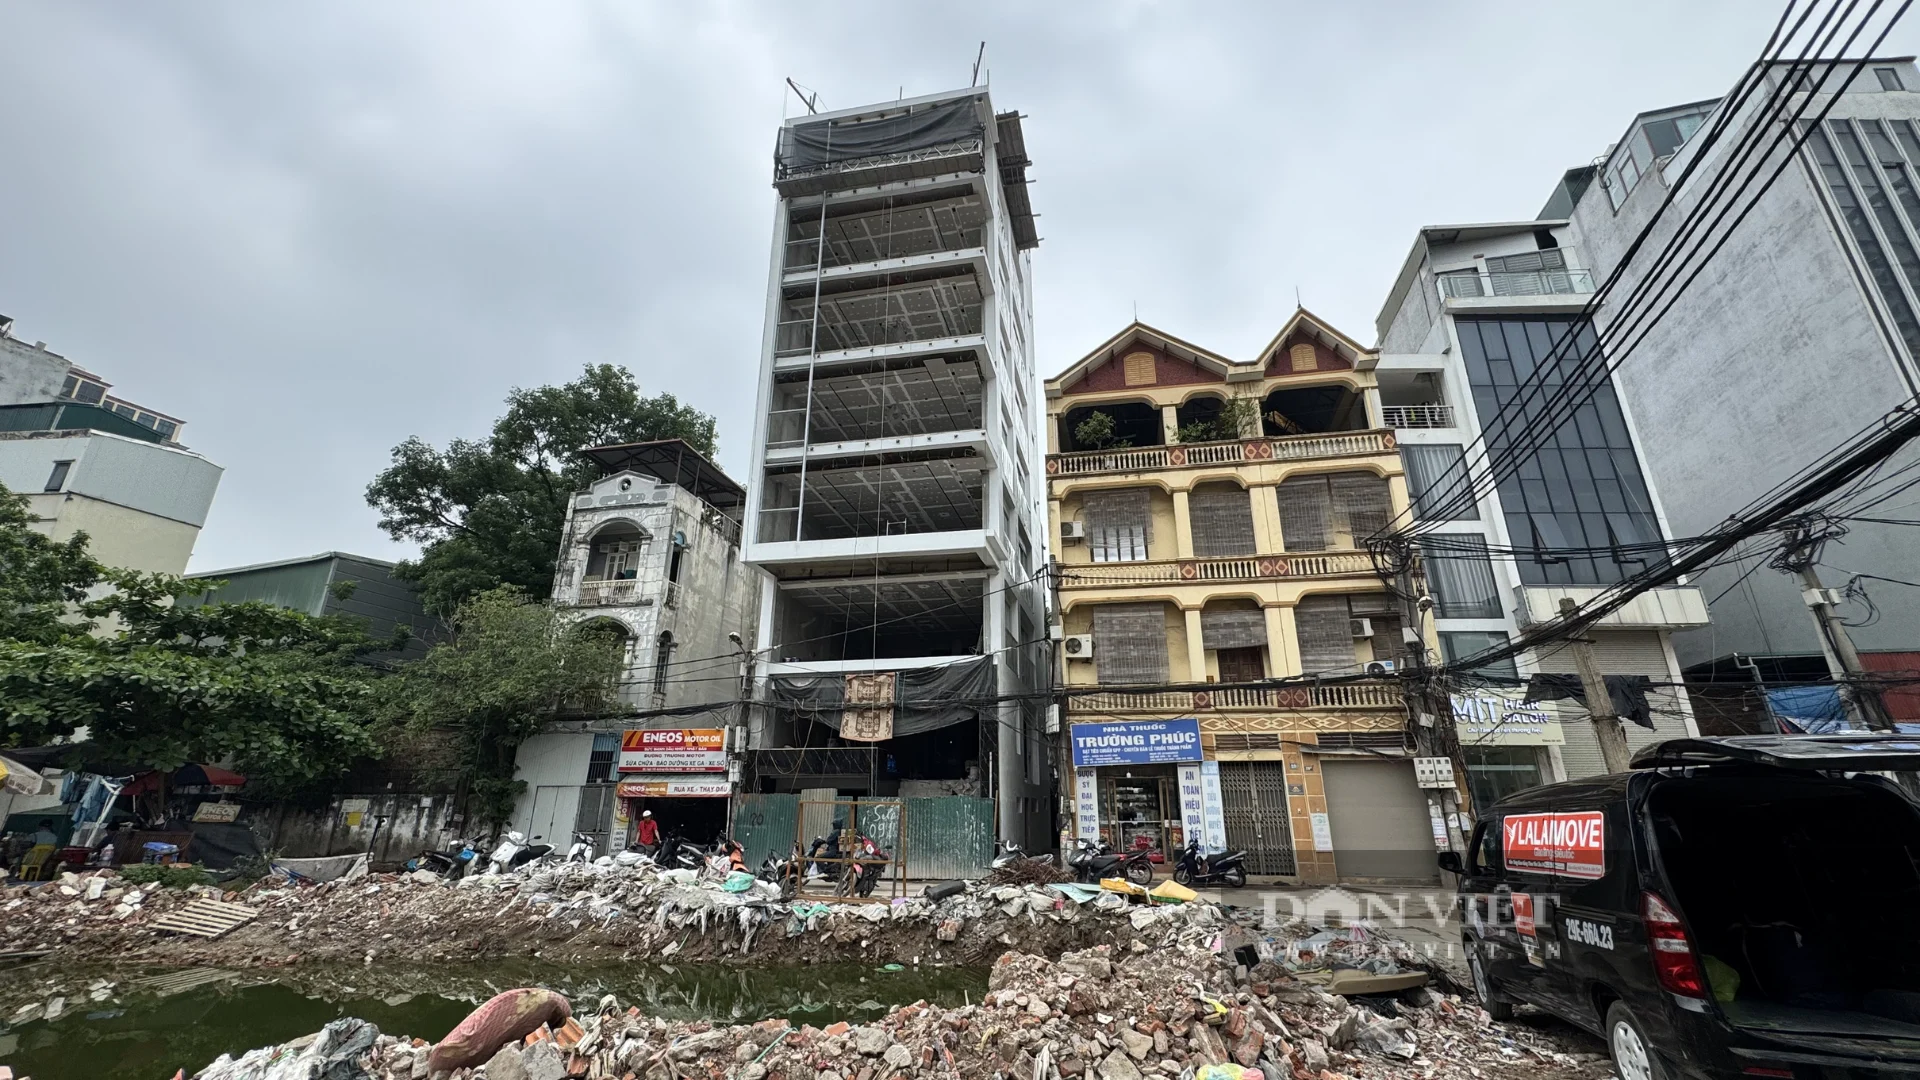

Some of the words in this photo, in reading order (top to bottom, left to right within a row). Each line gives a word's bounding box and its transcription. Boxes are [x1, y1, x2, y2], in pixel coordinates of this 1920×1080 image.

[1503, 699, 1541, 710] HAIR
[1503, 712, 1549, 723] SALON
[1103, 725, 1126, 733] NHÀ
[1129, 723, 1167, 731] THUỐC
[643, 732, 683, 743] ENEOS
[1076, 733, 1145, 748] TRƯỜNG
[1149, 730, 1196, 744] PHÚC
[1185, 771, 1194, 780] AN
[1182, 783, 1199, 795] TOÀN
[1081, 804, 1094, 812] HỌC
[1185, 799, 1200, 811] HIỆU
[1080, 814, 1096, 823] TRỰC
[1187, 812, 1201, 825] QUẢ
[1518, 819, 1601, 847] LALAMOVE
[1566, 918, 1614, 950] 29E-664.23
